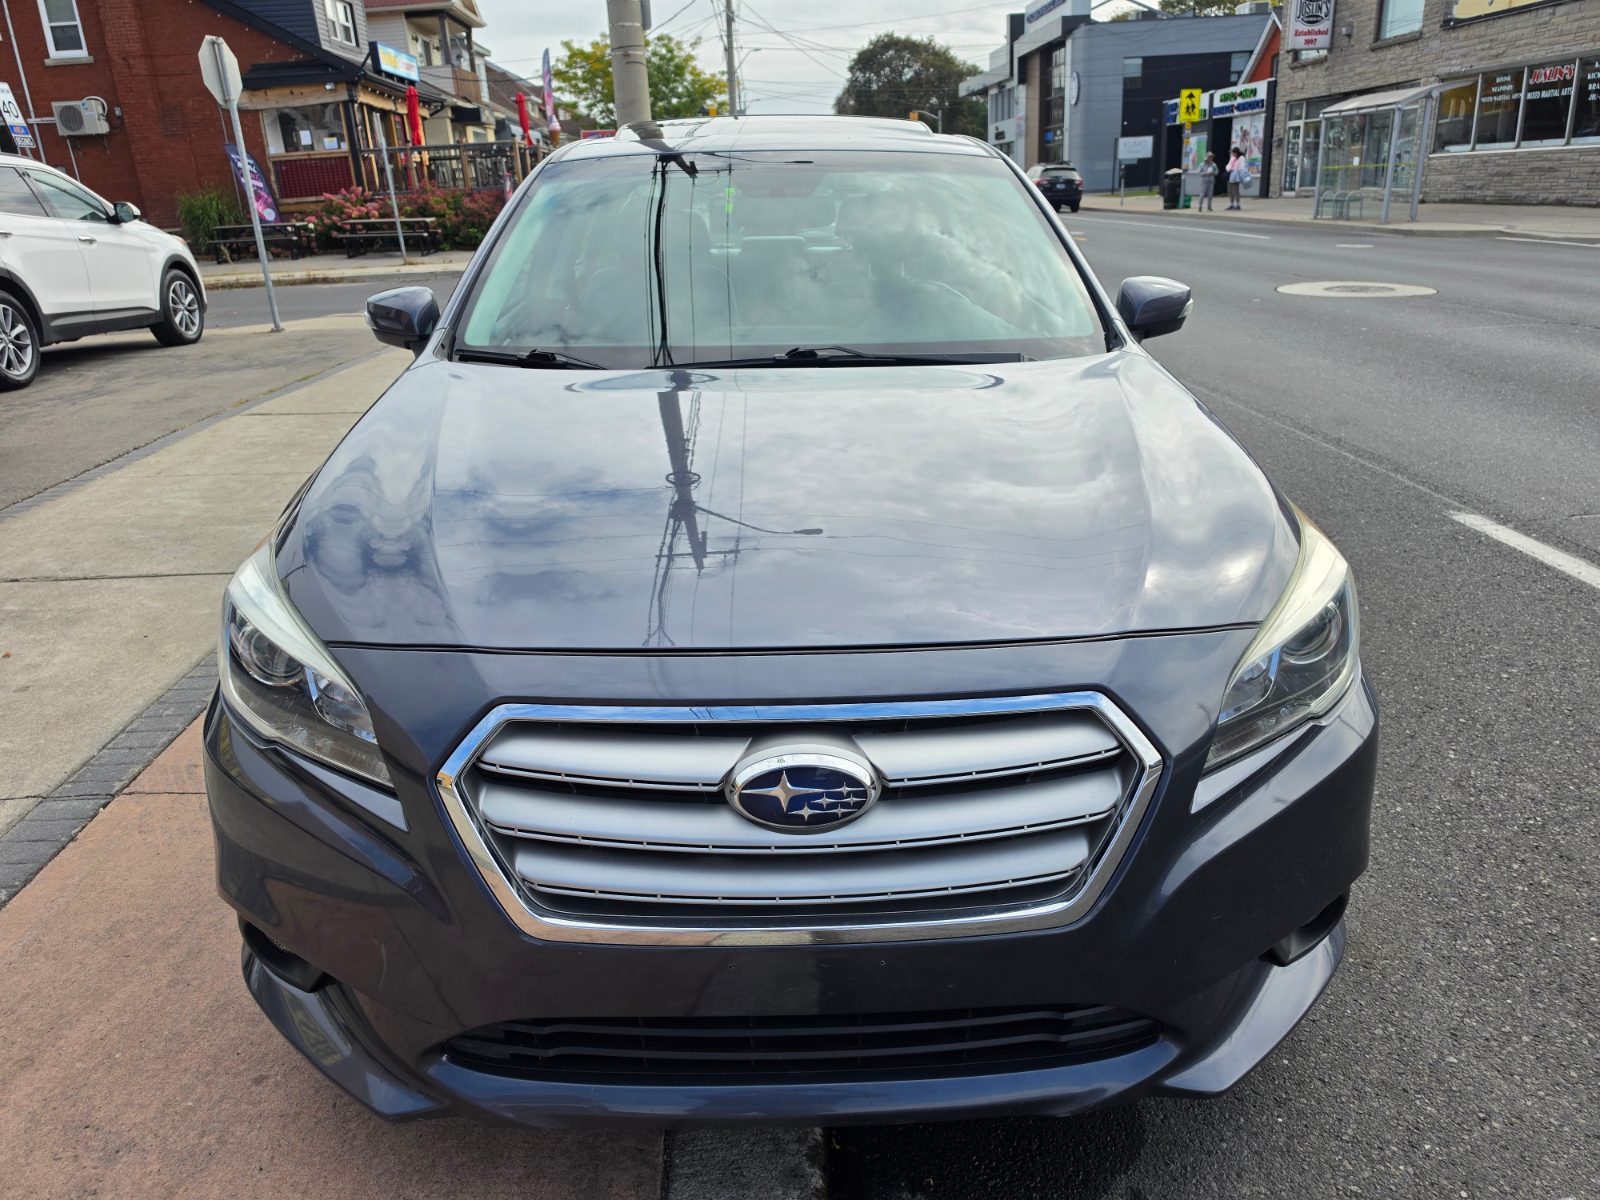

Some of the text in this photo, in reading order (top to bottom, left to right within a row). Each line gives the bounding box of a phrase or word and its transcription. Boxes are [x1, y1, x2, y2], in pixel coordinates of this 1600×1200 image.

[1295, 29, 1329, 37] Established
[1529, 64, 1575, 84] JOSLIN'S
[1527, 87, 1573, 100] MIXED MARTIAL ARTS
[3, 100, 19, 118] 40
